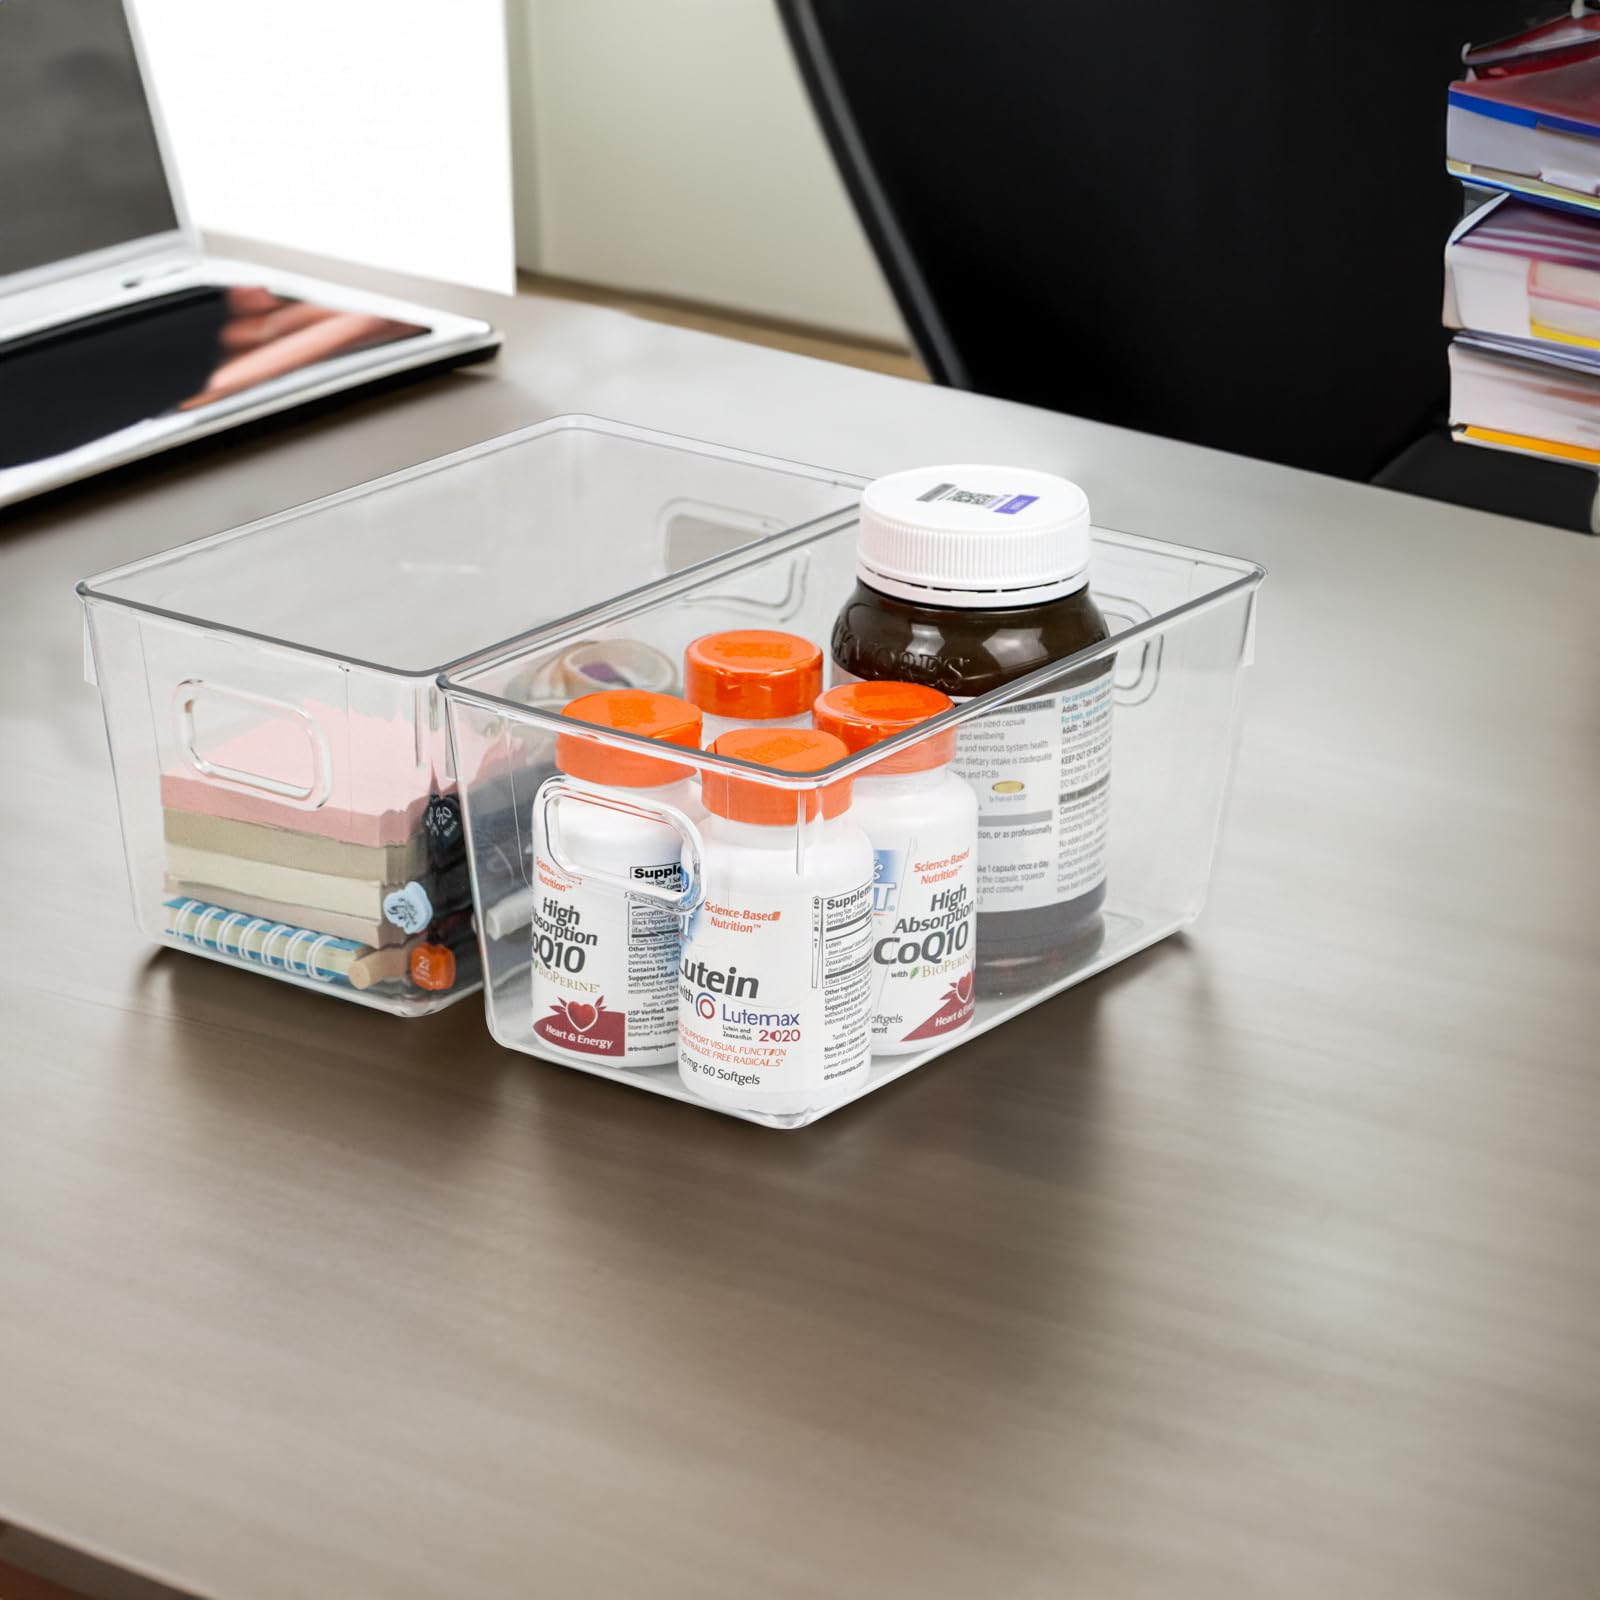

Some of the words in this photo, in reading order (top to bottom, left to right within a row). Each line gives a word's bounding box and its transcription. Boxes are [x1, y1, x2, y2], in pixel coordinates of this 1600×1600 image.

[913, 847, 970, 873] Science-Based
[930, 883, 967, 912] High
[542, 896, 581, 927] High
[892, 900, 974, 935] Absorption
[628, 945, 646, 953] Other
[873, 920, 968, 965] CoQ10
[628, 966, 656, 974] Contains
[891, 970, 908, 979] with
[628, 974, 659, 983] Suggested
[825, 987, 840, 996] Other
[824, 1000, 850, 1012] Suggested
[722, 1003, 800, 1027] Lutemax
[934, 1012, 957, 1028] Heart
[722, 1024, 739, 1032] Lutein
[545, 1023, 567, 1041] Heart
[567, 1032, 577, 1043] &
[577, 1034, 614, 1051] Energy
[722, 1030, 753, 1041] Zeaxanthin
[710, 1039, 738, 1054] VISUAL
[824, 1041, 847, 1053] Non-GMO
[713, 1050, 732, 1063] FREE
[702, 1064, 716, 1077] 60
[717, 1068, 761, 1086] Softgels
